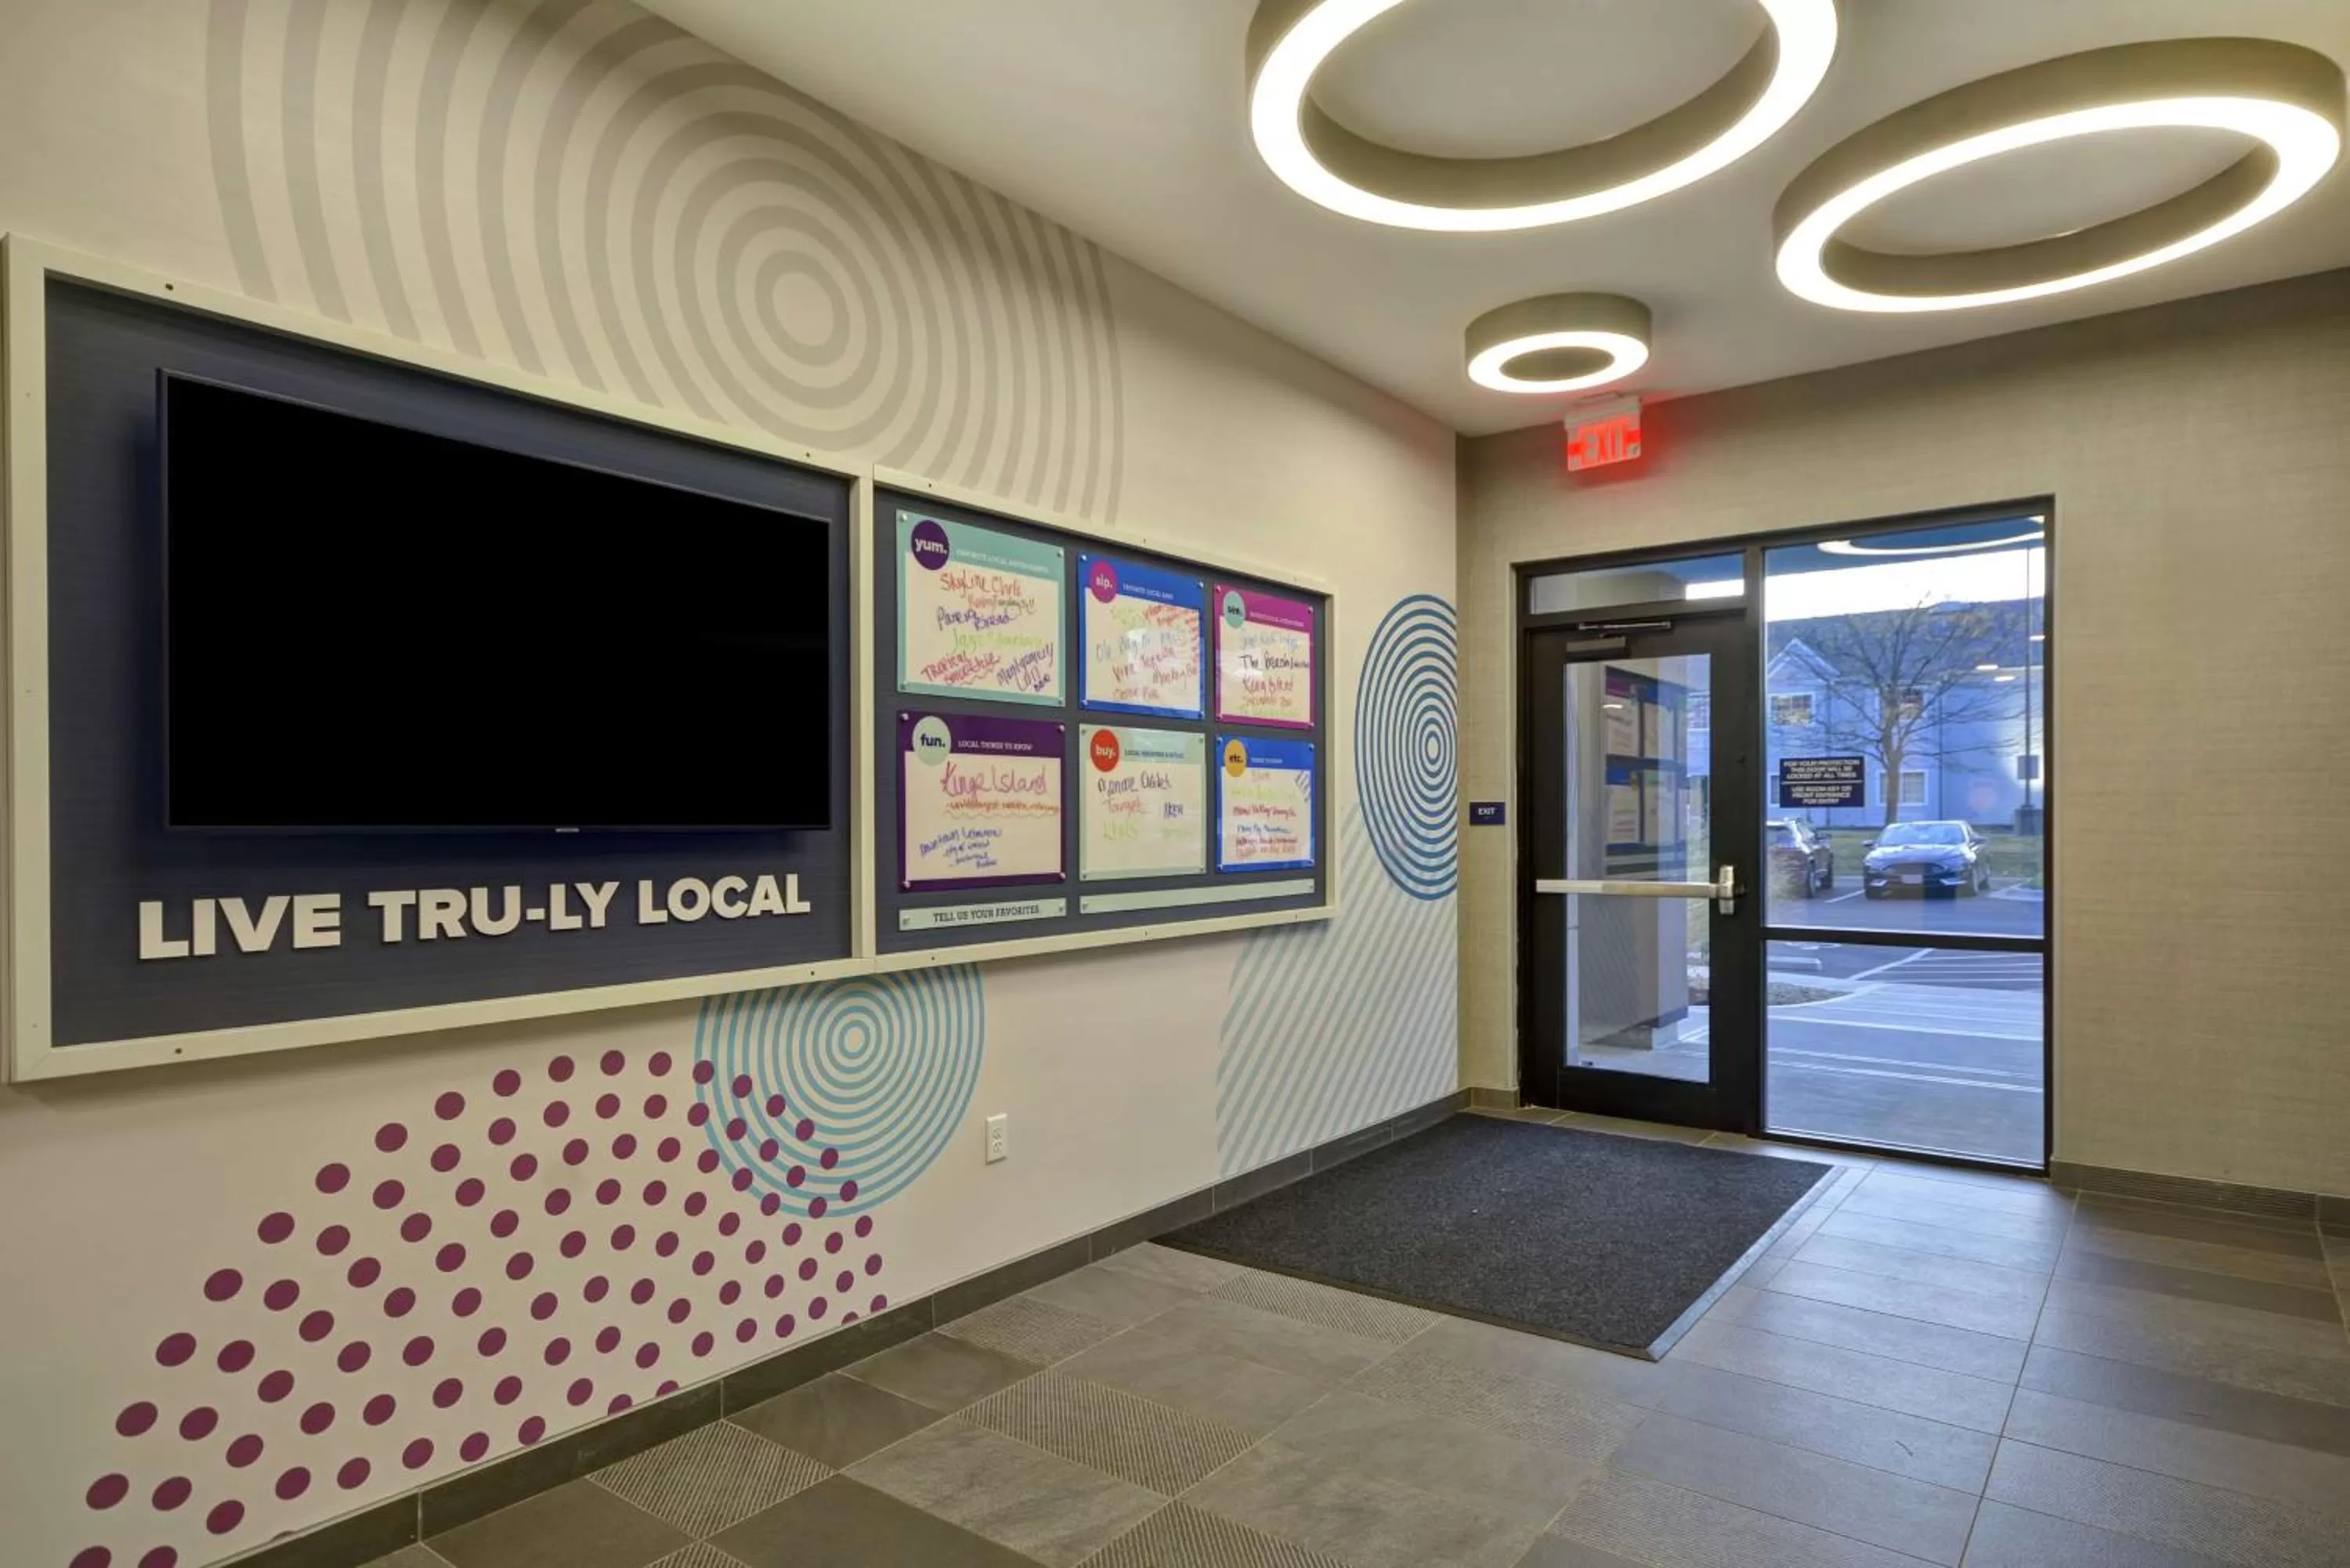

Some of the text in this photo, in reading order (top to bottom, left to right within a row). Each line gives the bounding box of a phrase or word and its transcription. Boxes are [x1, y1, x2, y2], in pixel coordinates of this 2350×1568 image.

[914, 537, 948, 554] yum.
[1096, 573, 1113, 589] sip.
[920, 733, 945, 748] fun.
[958, 740, 979, 749] LOCAL
[1096, 745, 1116, 760] buy.
[1228, 753, 1244, 764] etc.
[1477, 807, 1496, 815] EXIT
[139, 873, 812, 960] LIVE TRU-LY LOCAL
[933, 905, 1039, 922] TELL US YOUR FAVORITES
